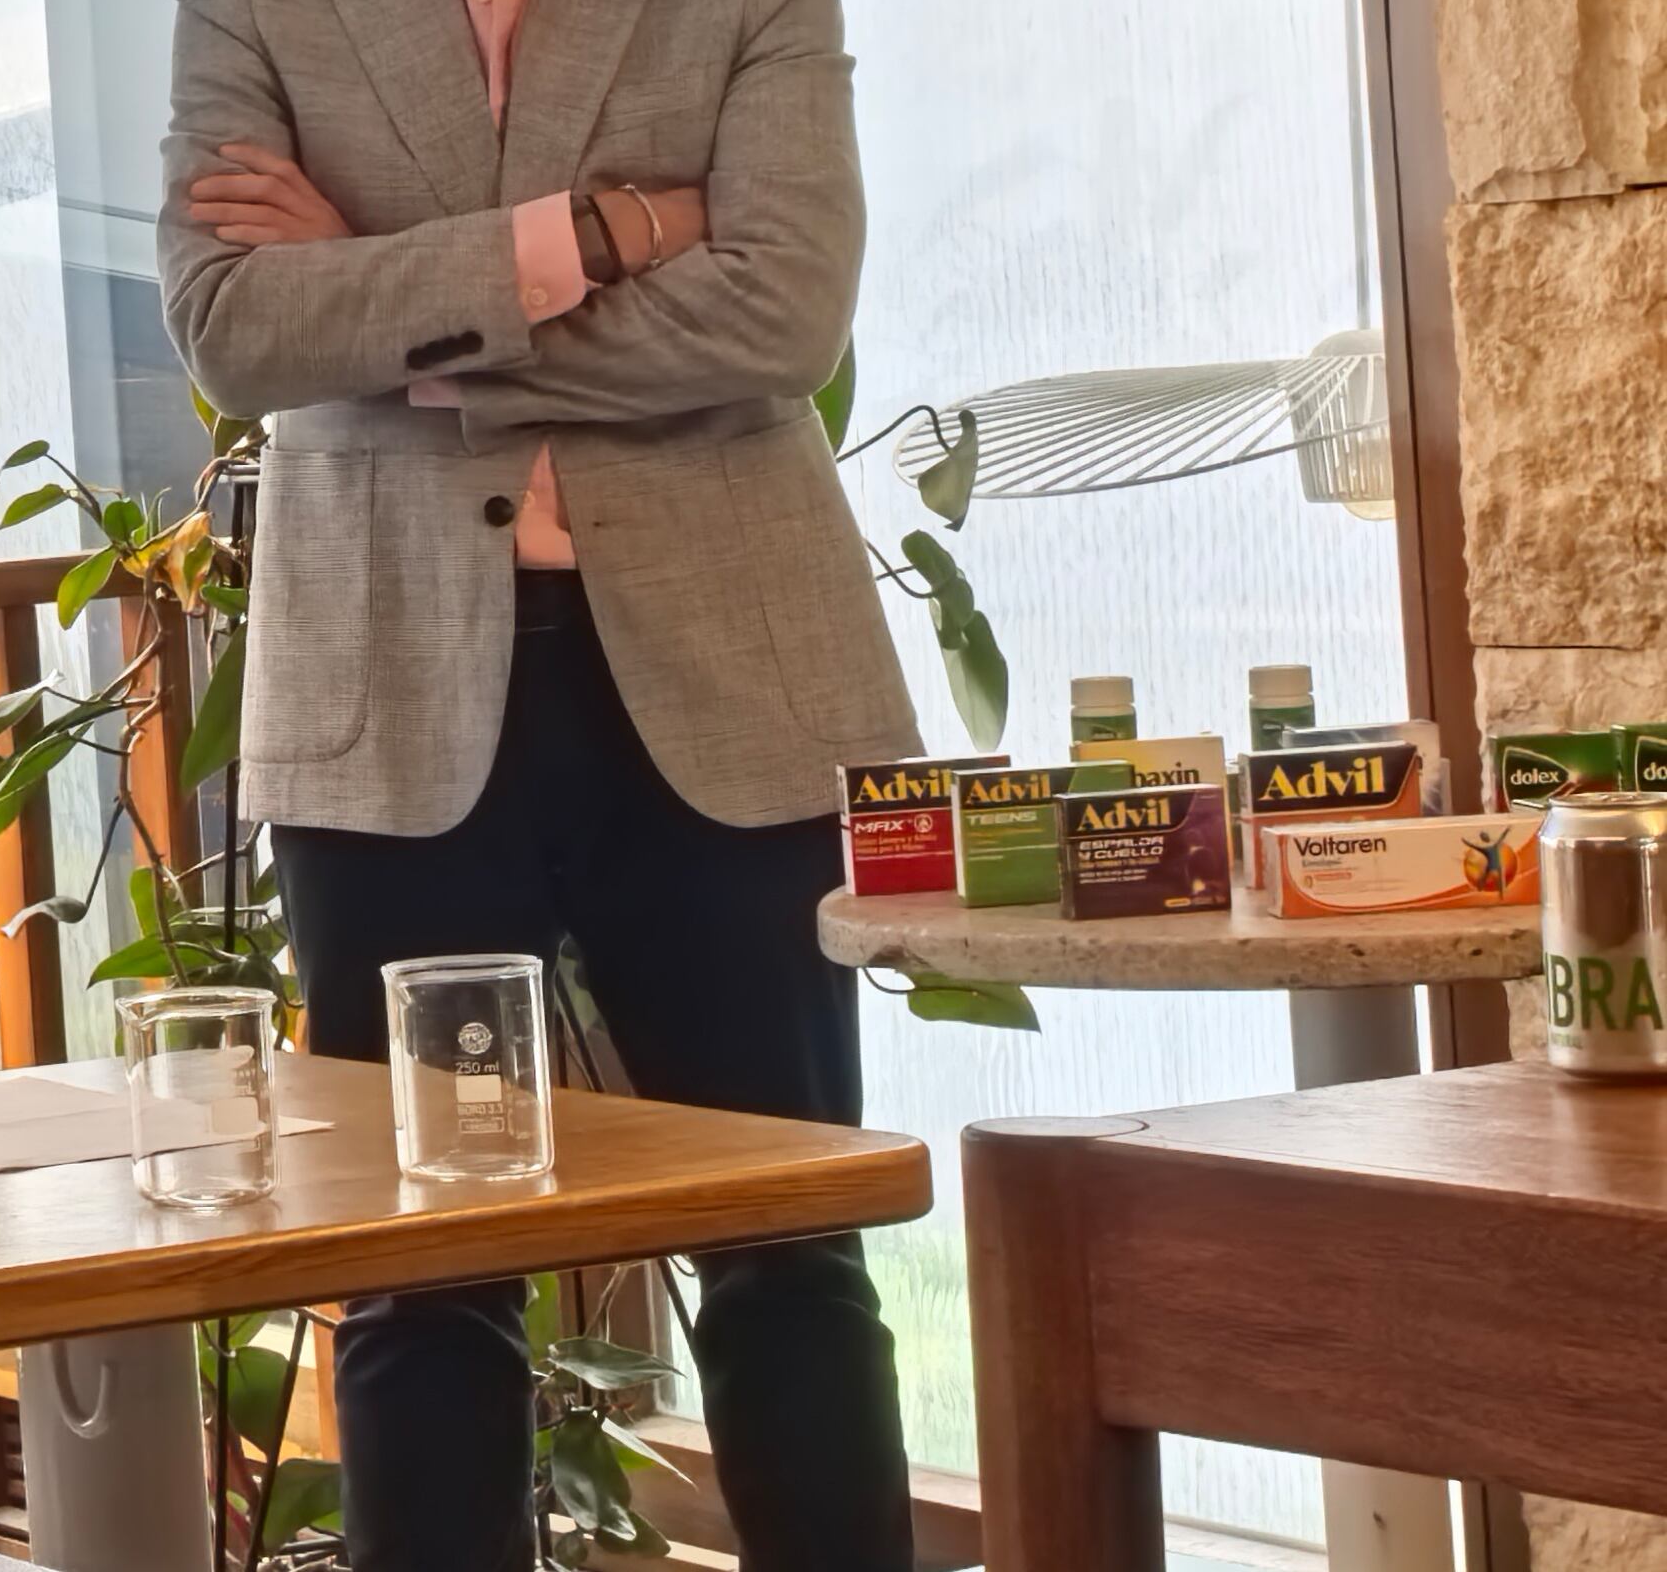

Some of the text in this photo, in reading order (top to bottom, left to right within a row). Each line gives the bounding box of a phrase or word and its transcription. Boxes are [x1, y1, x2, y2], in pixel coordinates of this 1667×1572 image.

[1130, 760, 1200, 786] baxin
[1257, 755, 1386, 802] Advil
[1510, 767, 1562, 786] dolex
[853, 768, 952, 804] Advil
[966, 773, 1052, 806] Advil
[968, 810, 1038, 826] TEENS
[1077, 795, 1172, 832] Advil
[854, 819, 905, 834] MAX
[1094, 846, 1164, 860] CUELLO
[1293, 835, 1387, 858] Voltaren
[1545, 952, 1664, 1031] BRA
[454, 1060, 500, 1076] 250 ml
